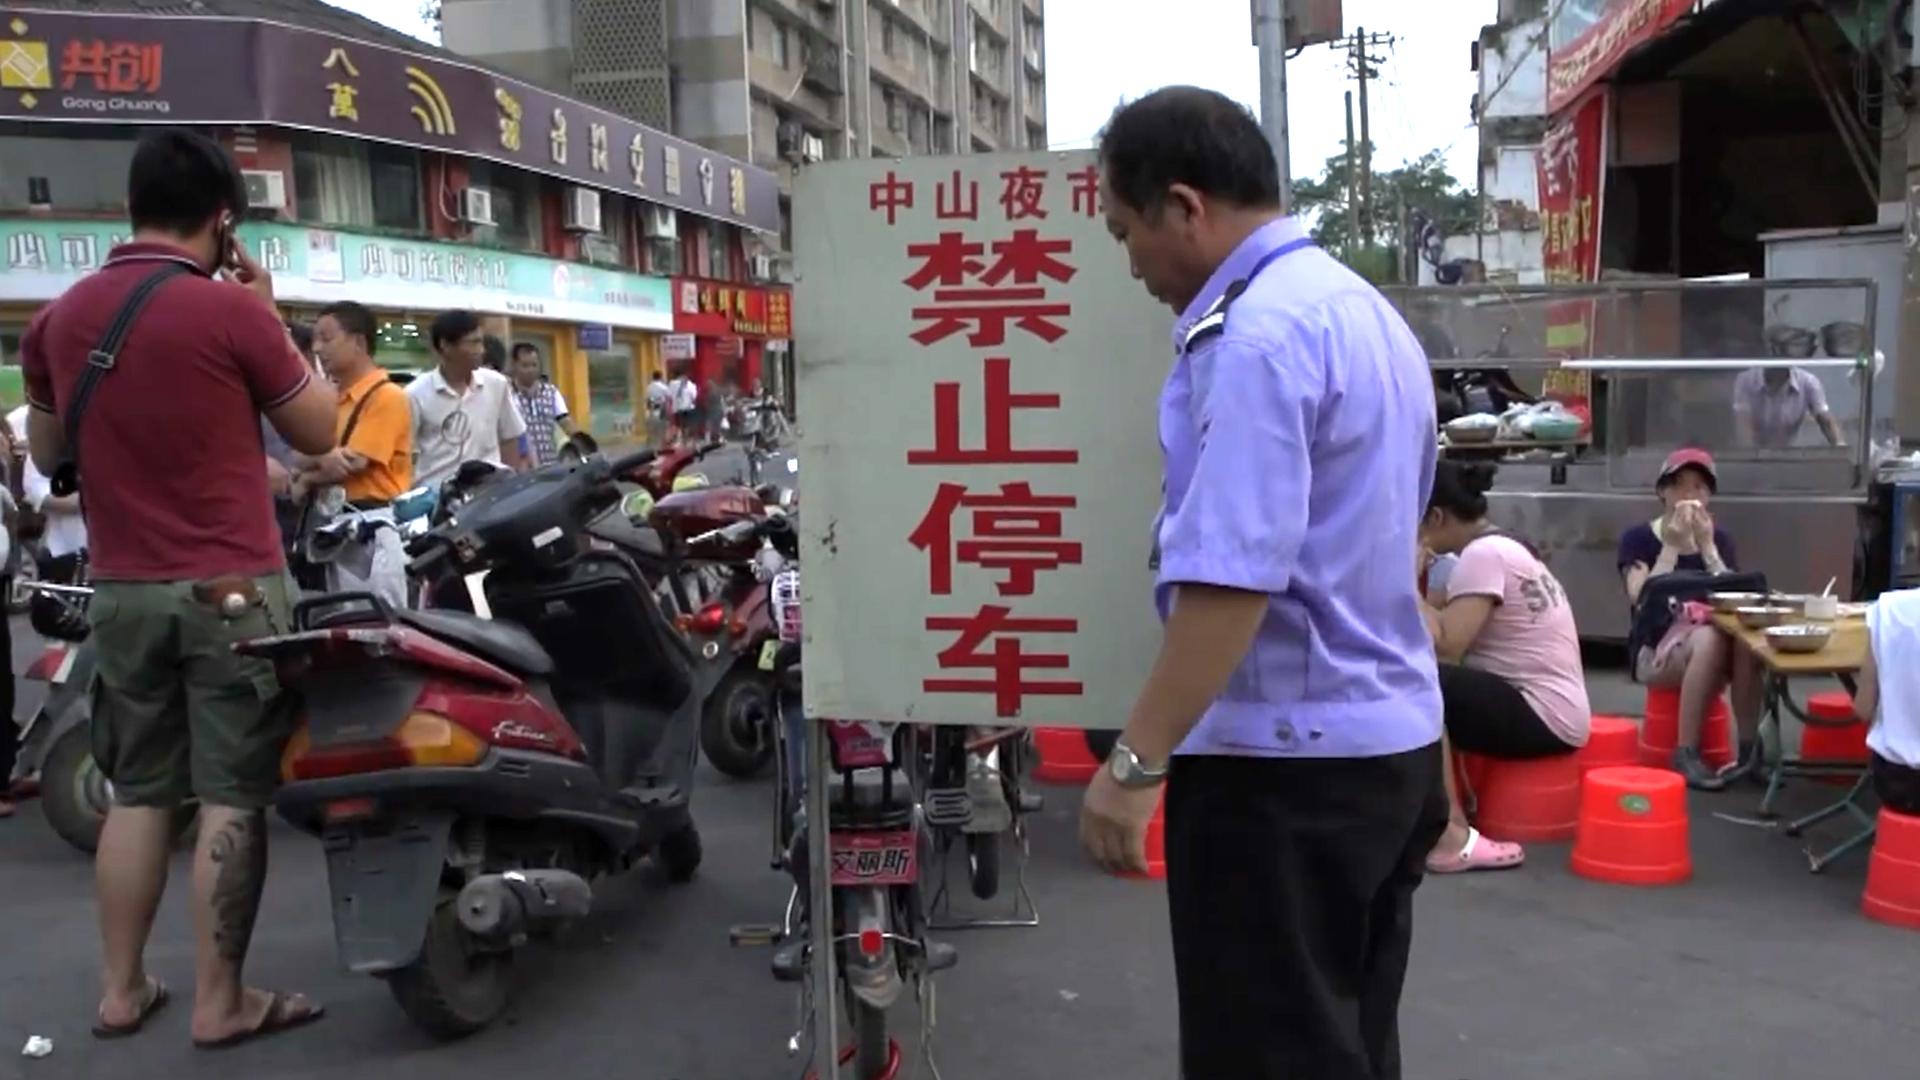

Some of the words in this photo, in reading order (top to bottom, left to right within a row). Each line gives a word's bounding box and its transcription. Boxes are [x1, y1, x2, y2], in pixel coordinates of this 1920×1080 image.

[61, 38, 164, 94] 共创
[61, 96, 106, 112] Gong
[108, 97, 171, 113] Chuang
[868, 164, 1102, 225] 中山夜市
[902, 228, 1084, 718] 禁止停车
